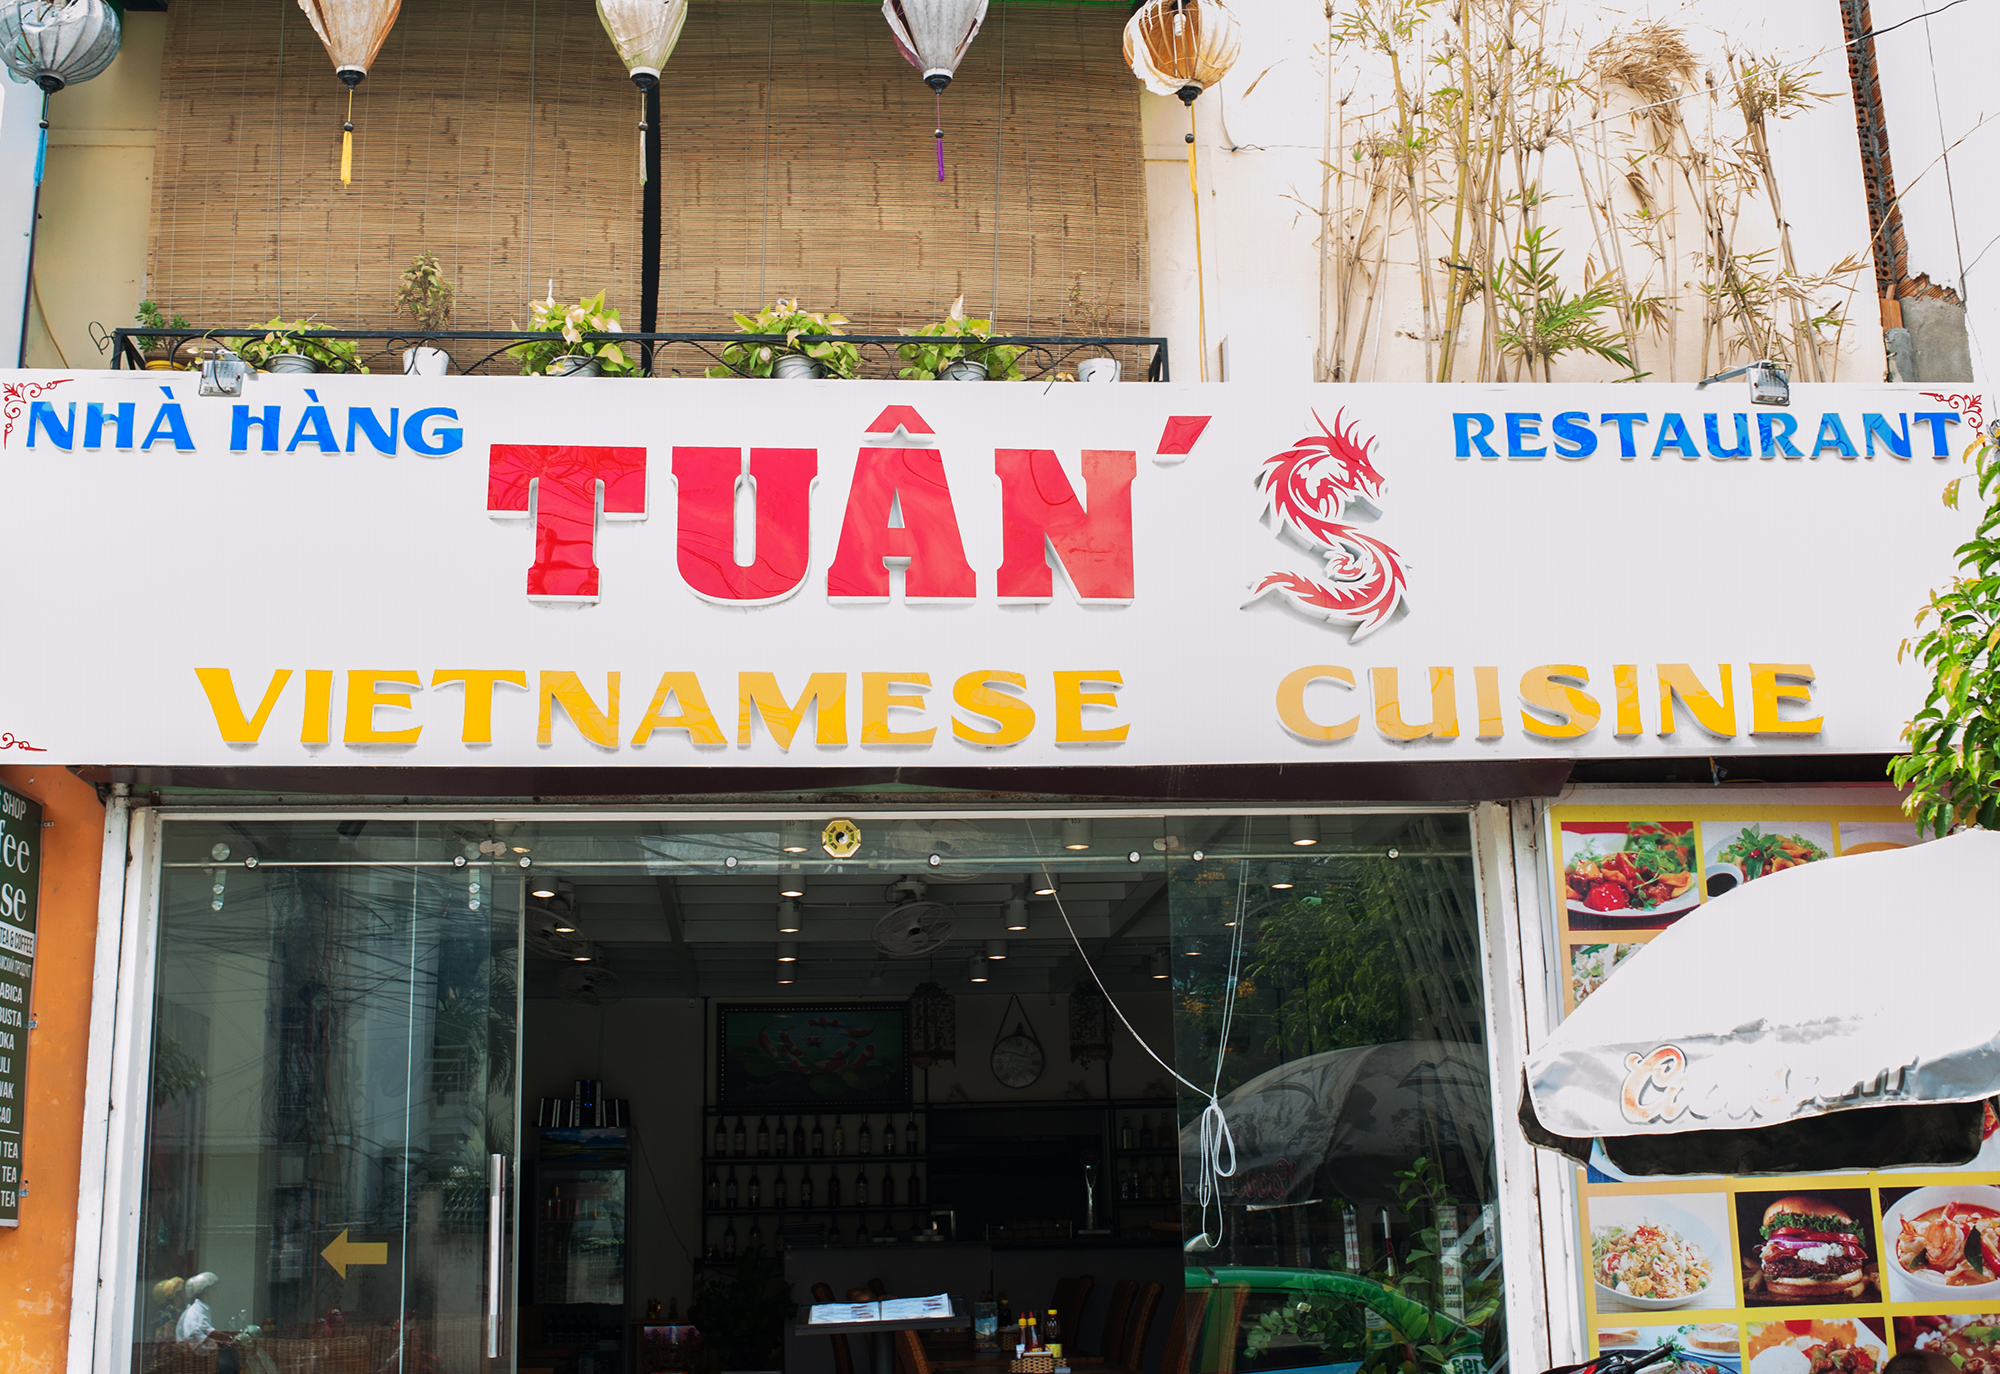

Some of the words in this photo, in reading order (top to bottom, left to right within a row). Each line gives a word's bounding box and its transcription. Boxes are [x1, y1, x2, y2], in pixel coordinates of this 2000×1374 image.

[26, 385, 196, 452] NHÀ
[229, 388, 464, 457] HÀNG
[1452, 411, 1961, 462] RESTAURANT
[194, 667, 1131, 751] VIETNAMESE
[1275, 662, 1826, 741] CUISINE
[2, 791, 27, 821] SHOP
[15, 932, 34, 955] COFFEE
[0, 981, 23, 1004] ABICA
[3, 1141, 18, 1159] TEA
[1, 1165, 17, 1183] TEA
[0, 1189, 16, 1208] TEA
